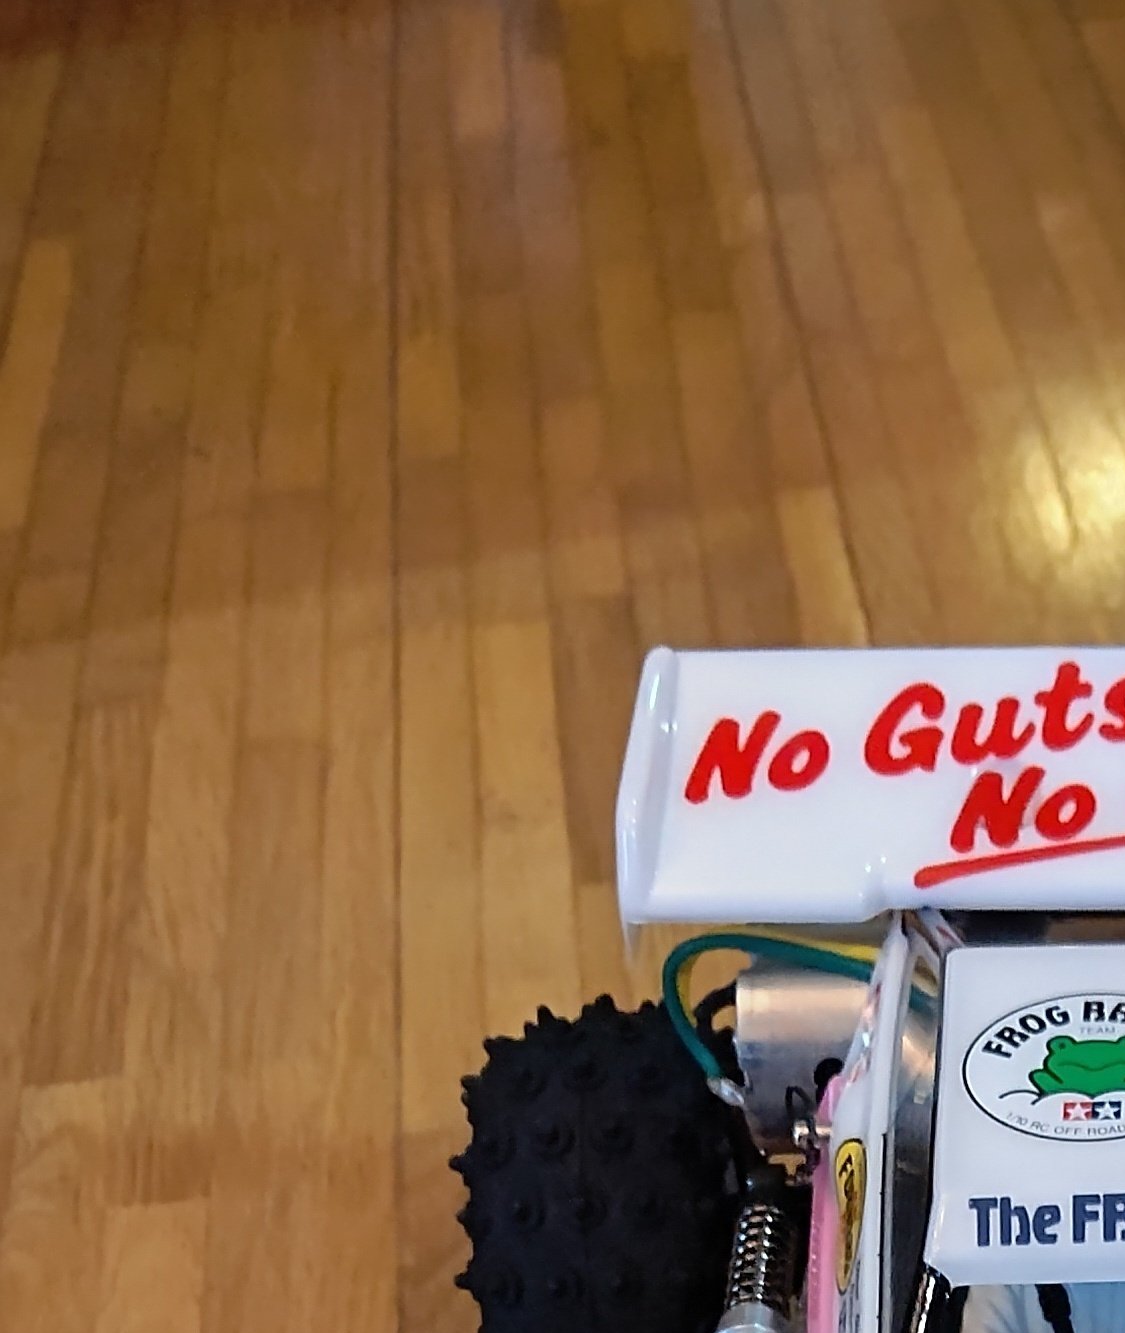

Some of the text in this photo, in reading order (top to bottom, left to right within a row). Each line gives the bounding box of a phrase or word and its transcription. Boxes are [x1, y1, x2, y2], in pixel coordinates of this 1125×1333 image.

[684, 710, 831, 804] No
[949, 766, 1097, 854] No
[981, 1005, 1070, 1060] FROG
[1079, 1024, 1116, 1035] TEAM
[1029, 1120, 1050, 1133] RC
[1053, 1126, 1083, 1136] OFF
[968, 1196, 1062, 1248] The
